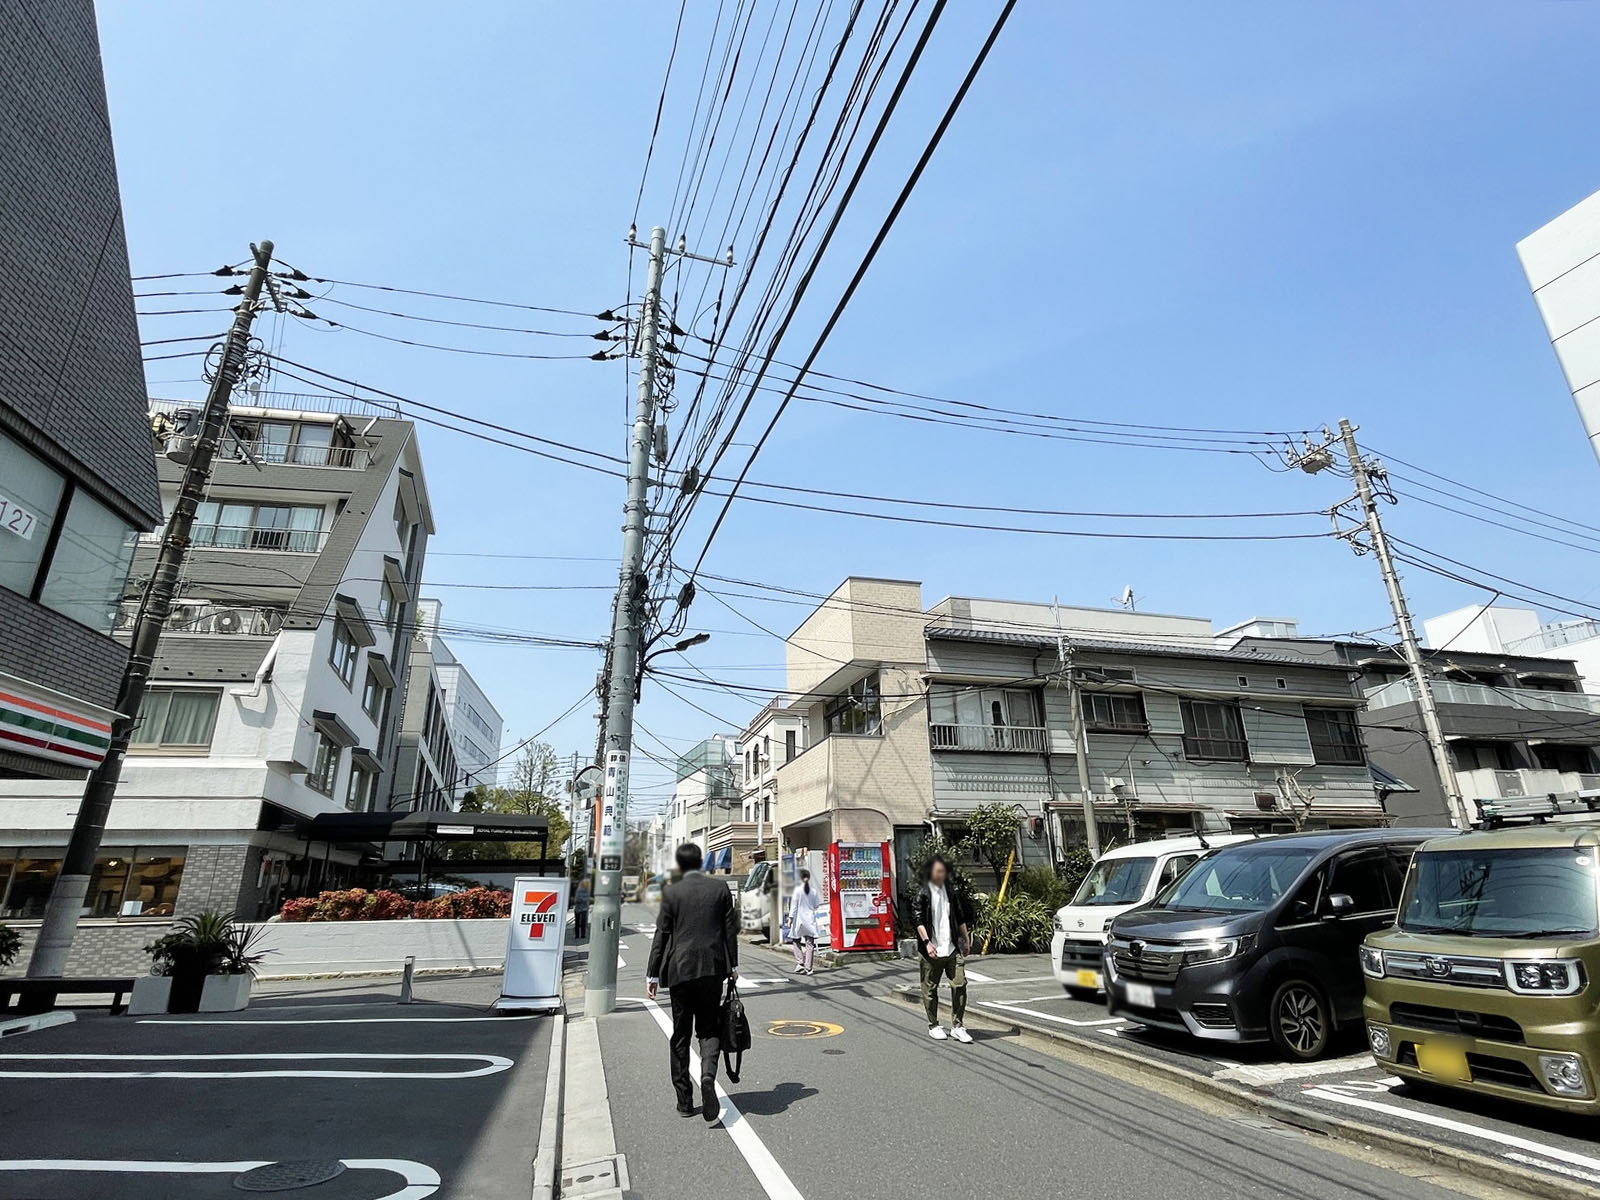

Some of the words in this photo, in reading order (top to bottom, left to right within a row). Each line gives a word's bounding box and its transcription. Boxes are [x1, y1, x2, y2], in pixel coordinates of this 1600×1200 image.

[603, 767, 615, 836] 青山典範
[524, 891, 558, 938] 7
